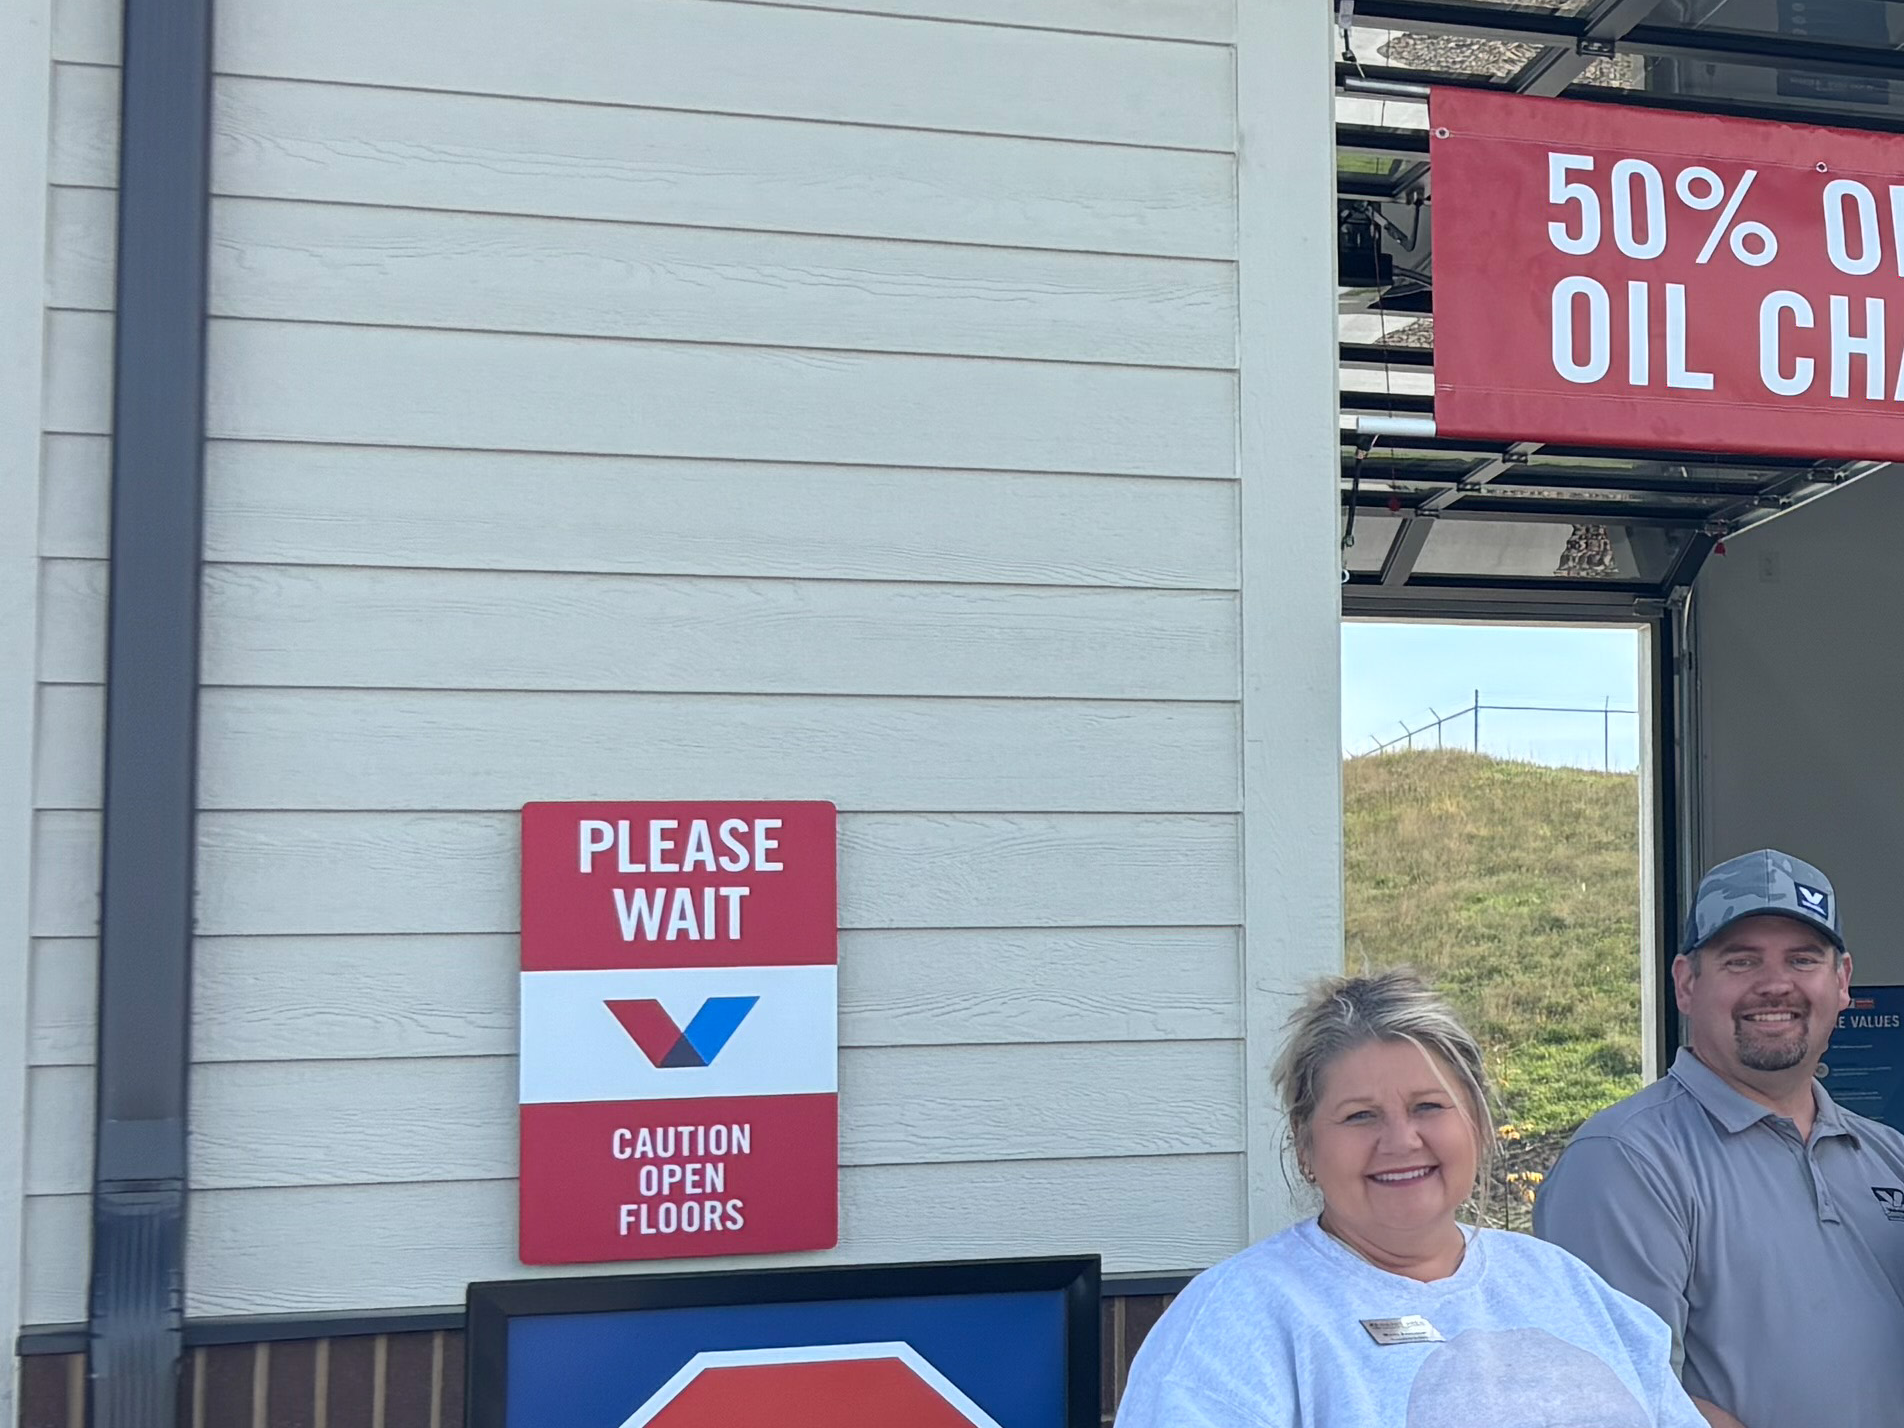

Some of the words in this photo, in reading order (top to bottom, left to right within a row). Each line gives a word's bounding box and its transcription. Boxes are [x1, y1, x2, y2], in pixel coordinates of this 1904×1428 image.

[1548, 151, 1778, 267] 50%
[1552, 276, 1714, 391] OIL
[579, 819, 784, 873] PLEASE
[613, 886, 750, 941] WAIT
[1850, 1015, 1900, 1028] VALUES
[612, 1124, 751, 1159] CAUTION
[639, 1163, 725, 1196] OPEN
[619, 1199, 744, 1235] FLOORS
